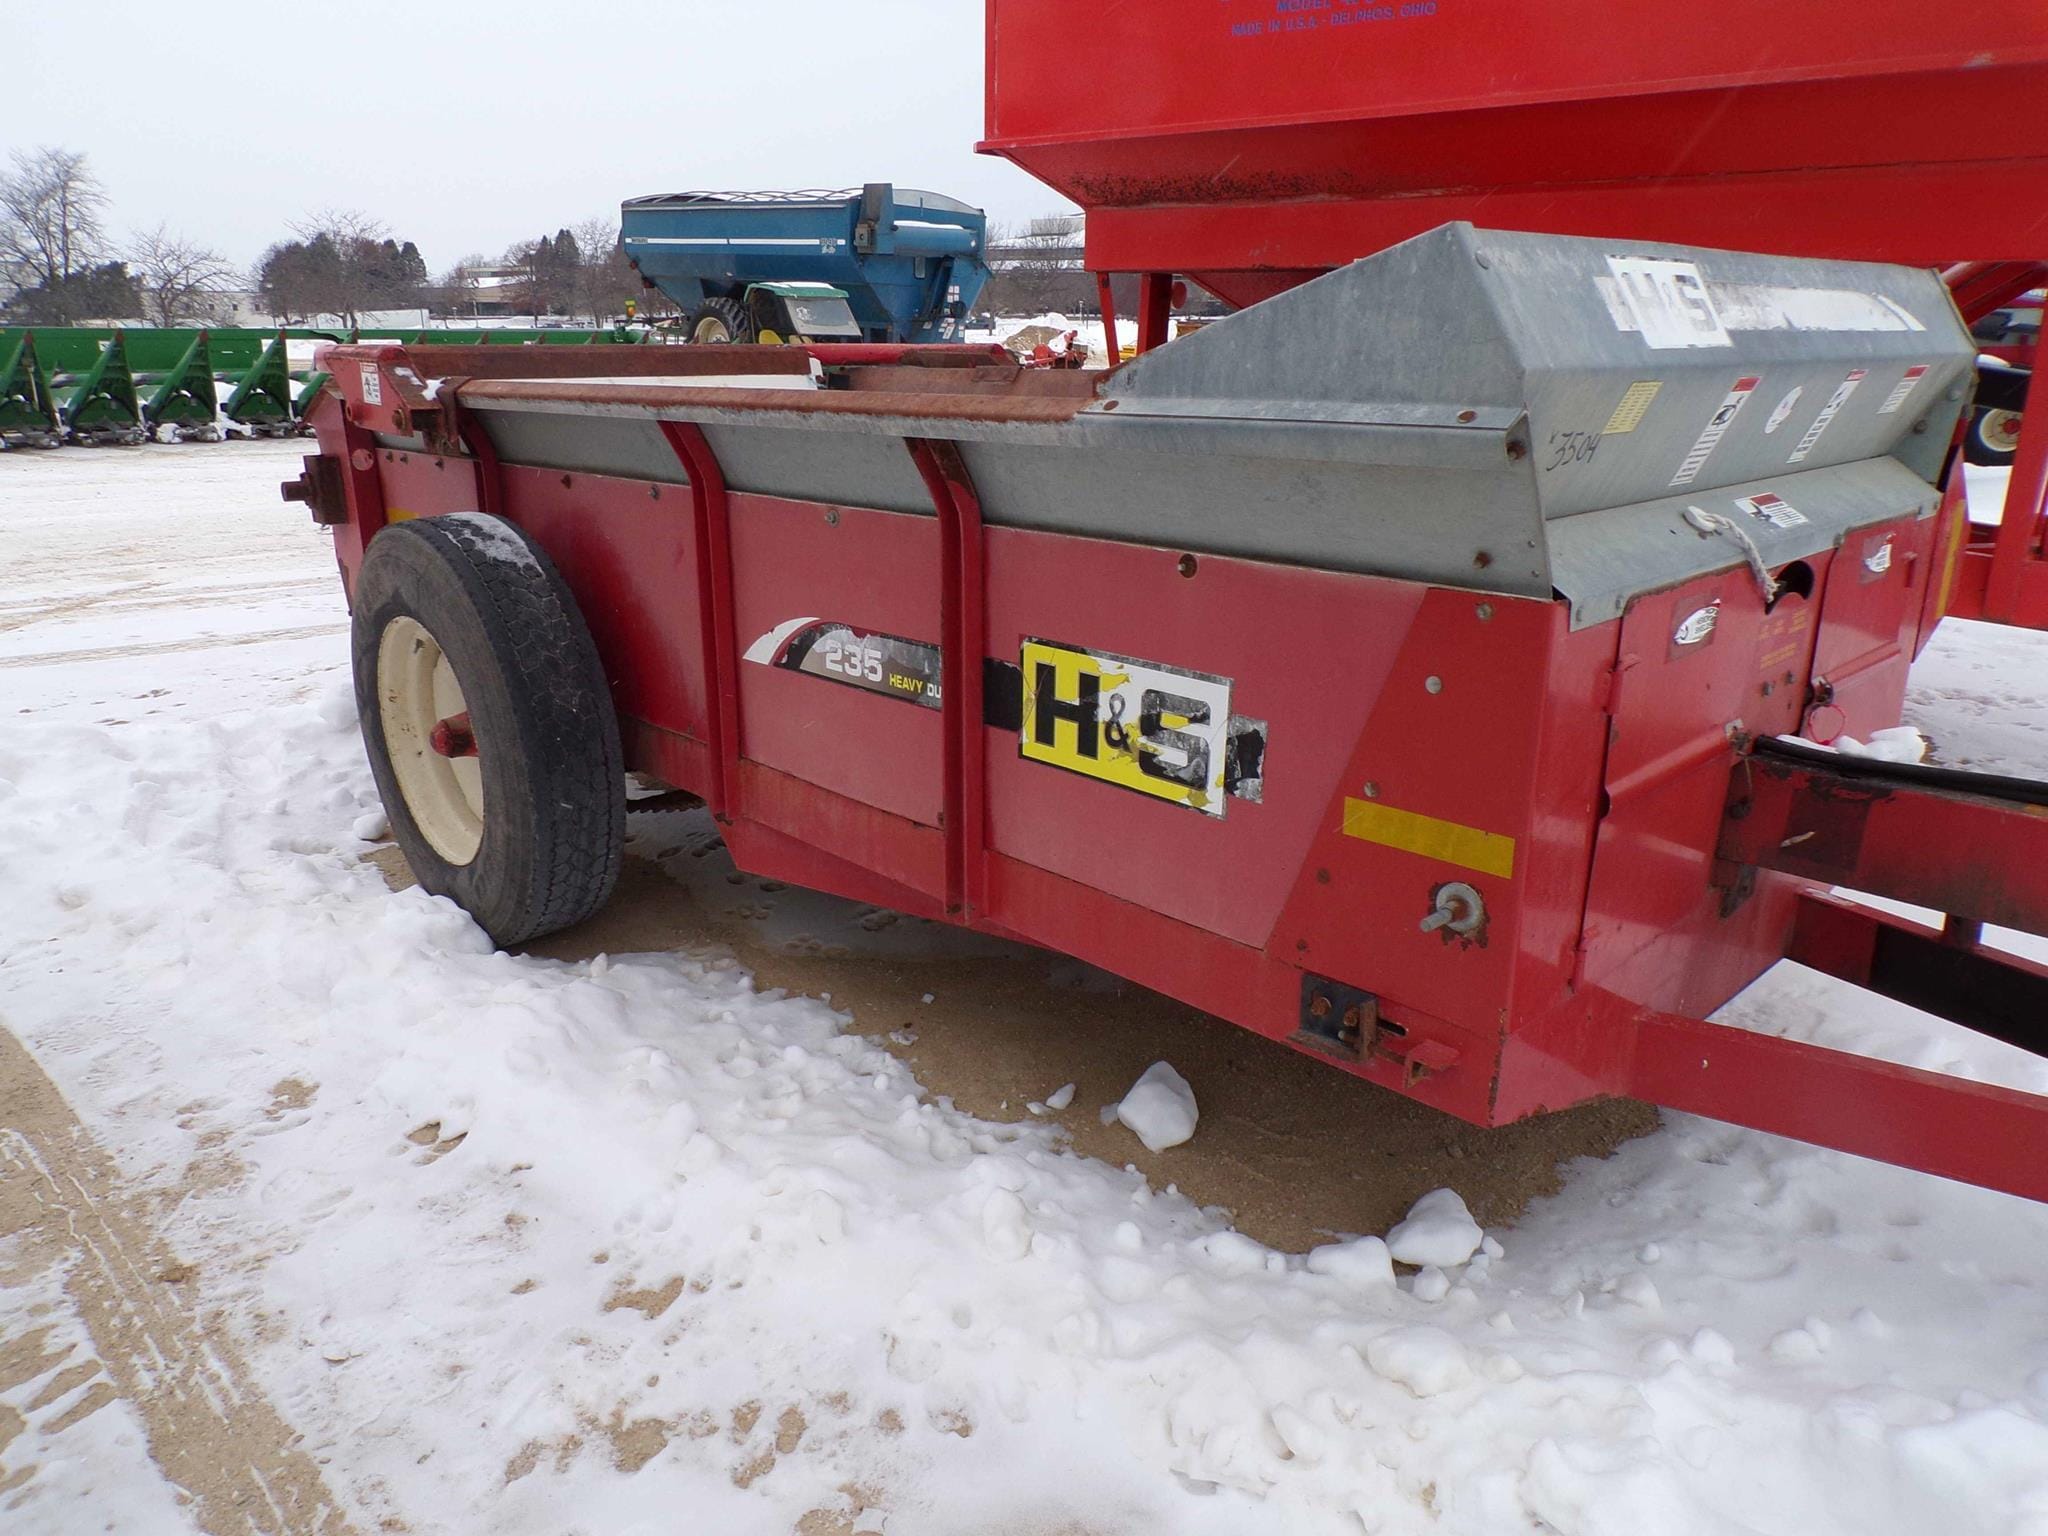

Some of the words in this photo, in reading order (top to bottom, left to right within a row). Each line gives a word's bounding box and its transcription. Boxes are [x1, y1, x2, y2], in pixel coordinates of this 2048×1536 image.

[1231, 22, 1262, 36] MADE
[1268, 19, 1281, 33] IN
[1399, 1, 1438, 17] OHIO
[825, 640, 883, 683] 235
[888, 672, 924, 694] HEAVY
